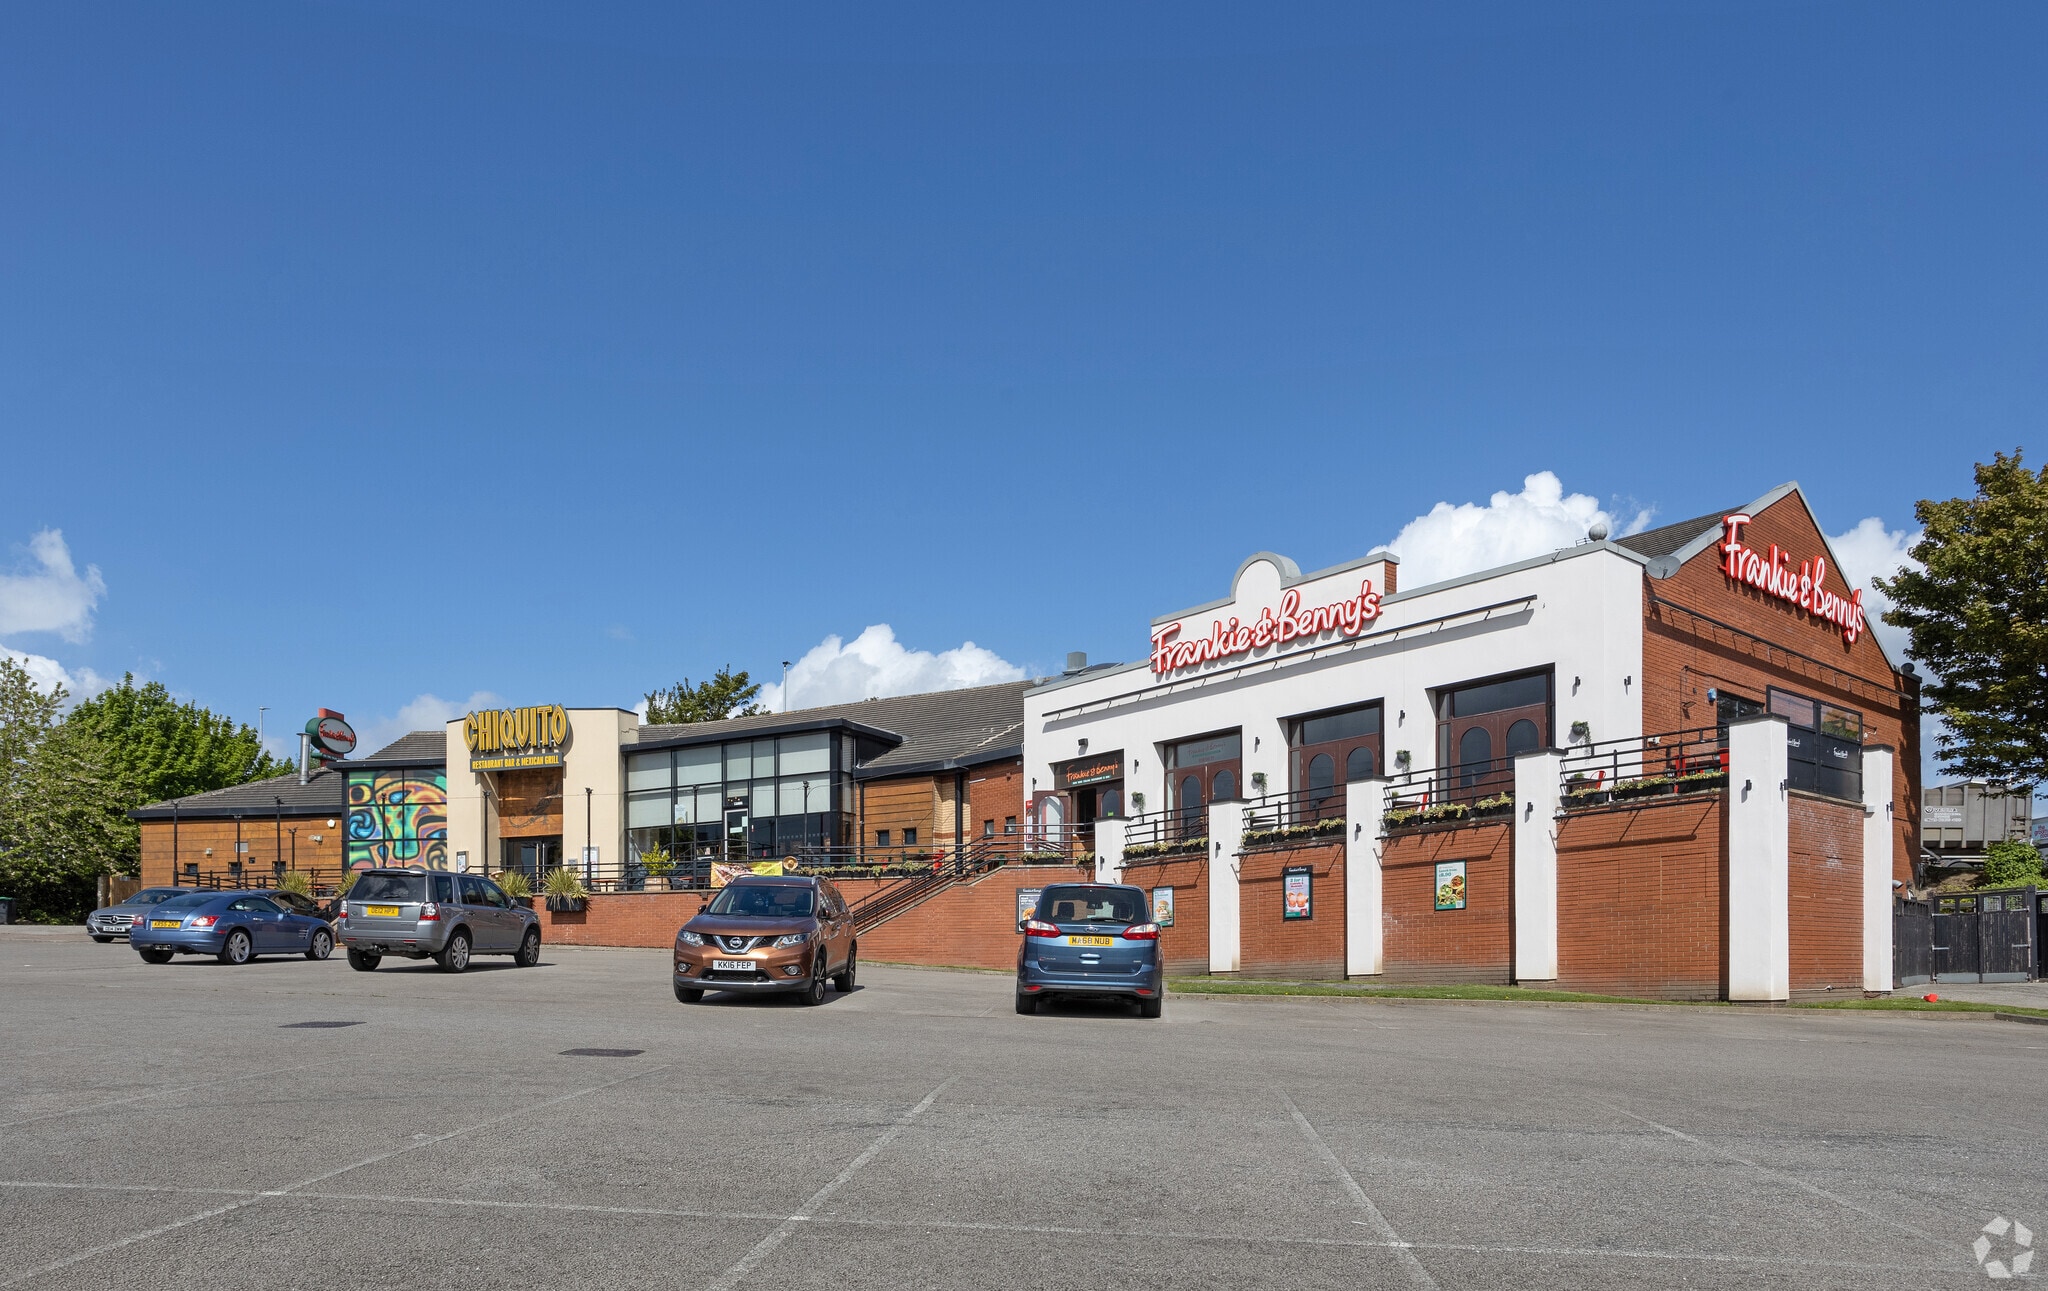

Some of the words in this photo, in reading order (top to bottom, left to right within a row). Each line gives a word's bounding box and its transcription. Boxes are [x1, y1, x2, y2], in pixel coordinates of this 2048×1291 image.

[1720, 513, 1798, 604] Frankie
[1798, 560, 1812, 609] &
[1809, 555, 1865, 644] Benny's
[1151, 617, 1251, 673] Frankie
[1251, 607, 1277, 648] &
[1277, 579, 1382, 642] Benny's
[463, 703, 570, 753] CHIQUITO
[472, 758, 503, 769] RESTAURANT
[504, 758, 515, 767] BAR
[521, 756, 543, 766] MEXICAN
[544, 755, 560, 764] GRILL
[1066, 764, 1090, 782] Frankie
[1094, 937, 1110, 945] NUB
[718, 961, 735, 969] KK16
[736, 961, 752, 969] FEP
